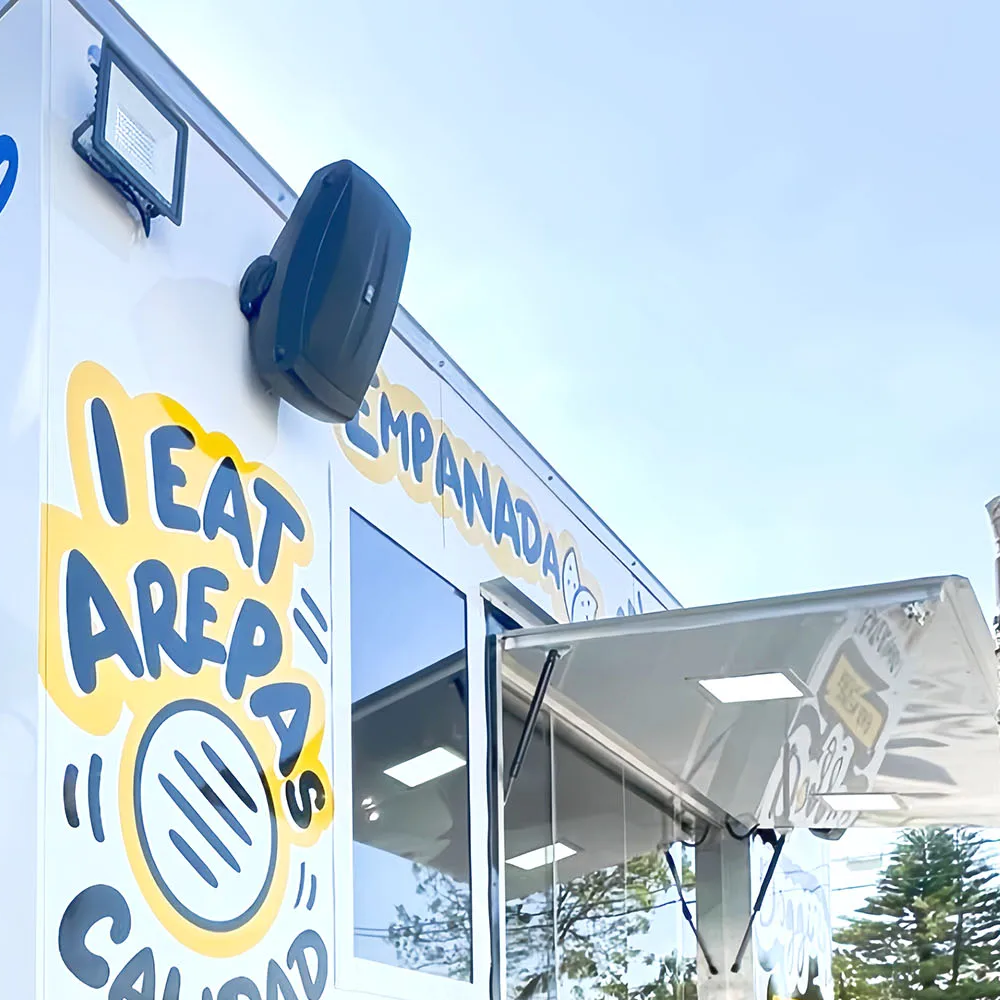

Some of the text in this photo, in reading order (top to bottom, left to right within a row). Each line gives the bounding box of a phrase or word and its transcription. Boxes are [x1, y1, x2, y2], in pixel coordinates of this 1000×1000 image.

[88, 397, 305, 584] I EAT
[65, 548, 325, 829] AREPAS
